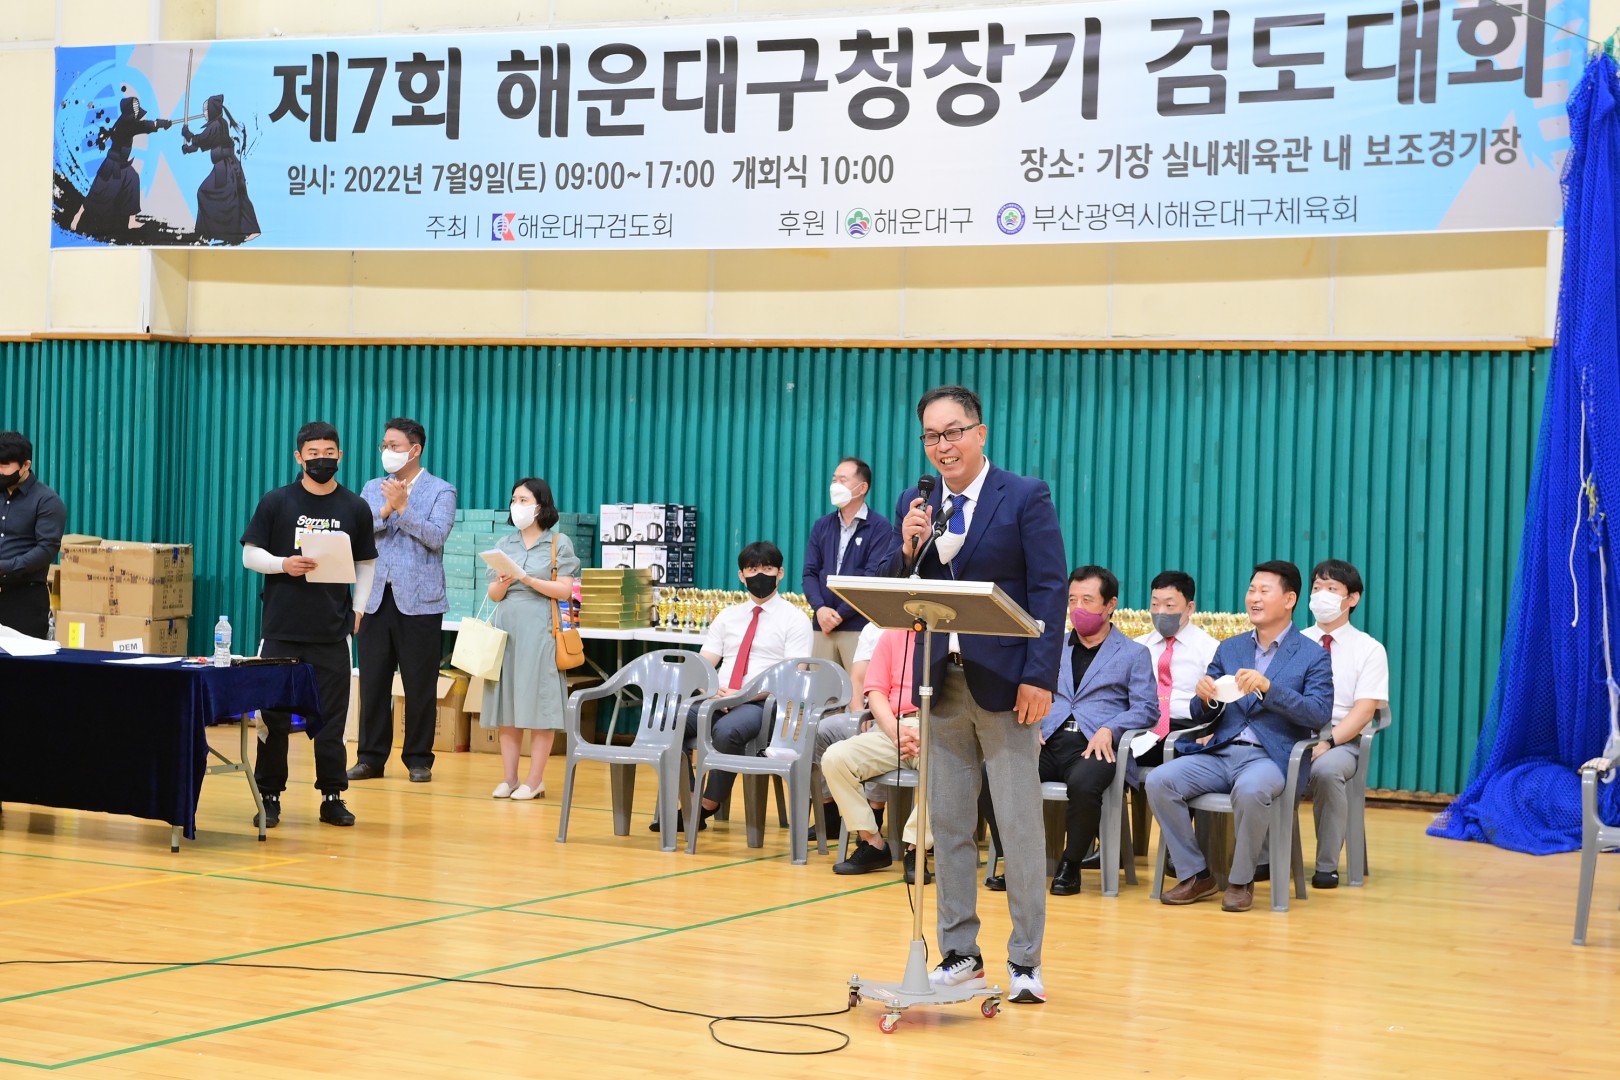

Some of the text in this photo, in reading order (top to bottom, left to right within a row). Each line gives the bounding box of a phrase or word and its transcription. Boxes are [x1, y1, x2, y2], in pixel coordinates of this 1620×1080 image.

[268, 0, 1547, 143] 제7회 해운대구청장기 검도대회
[1019, 125, 1522, 183] 장소: 기장 실내체육관 내 보조경기장
[287, 154, 895, 196] 일시: 2022년 7월9일(토) 09:00~17:00 개회식 10:00
[425, 214, 467, 240] 주최
[518, 212, 673, 240] 해운대구검도회
[777, 209, 825, 237] 후원
[874, 207, 974, 235] 해운대구
[1031, 194, 1358, 232] 부산광역시해운대구체육회
